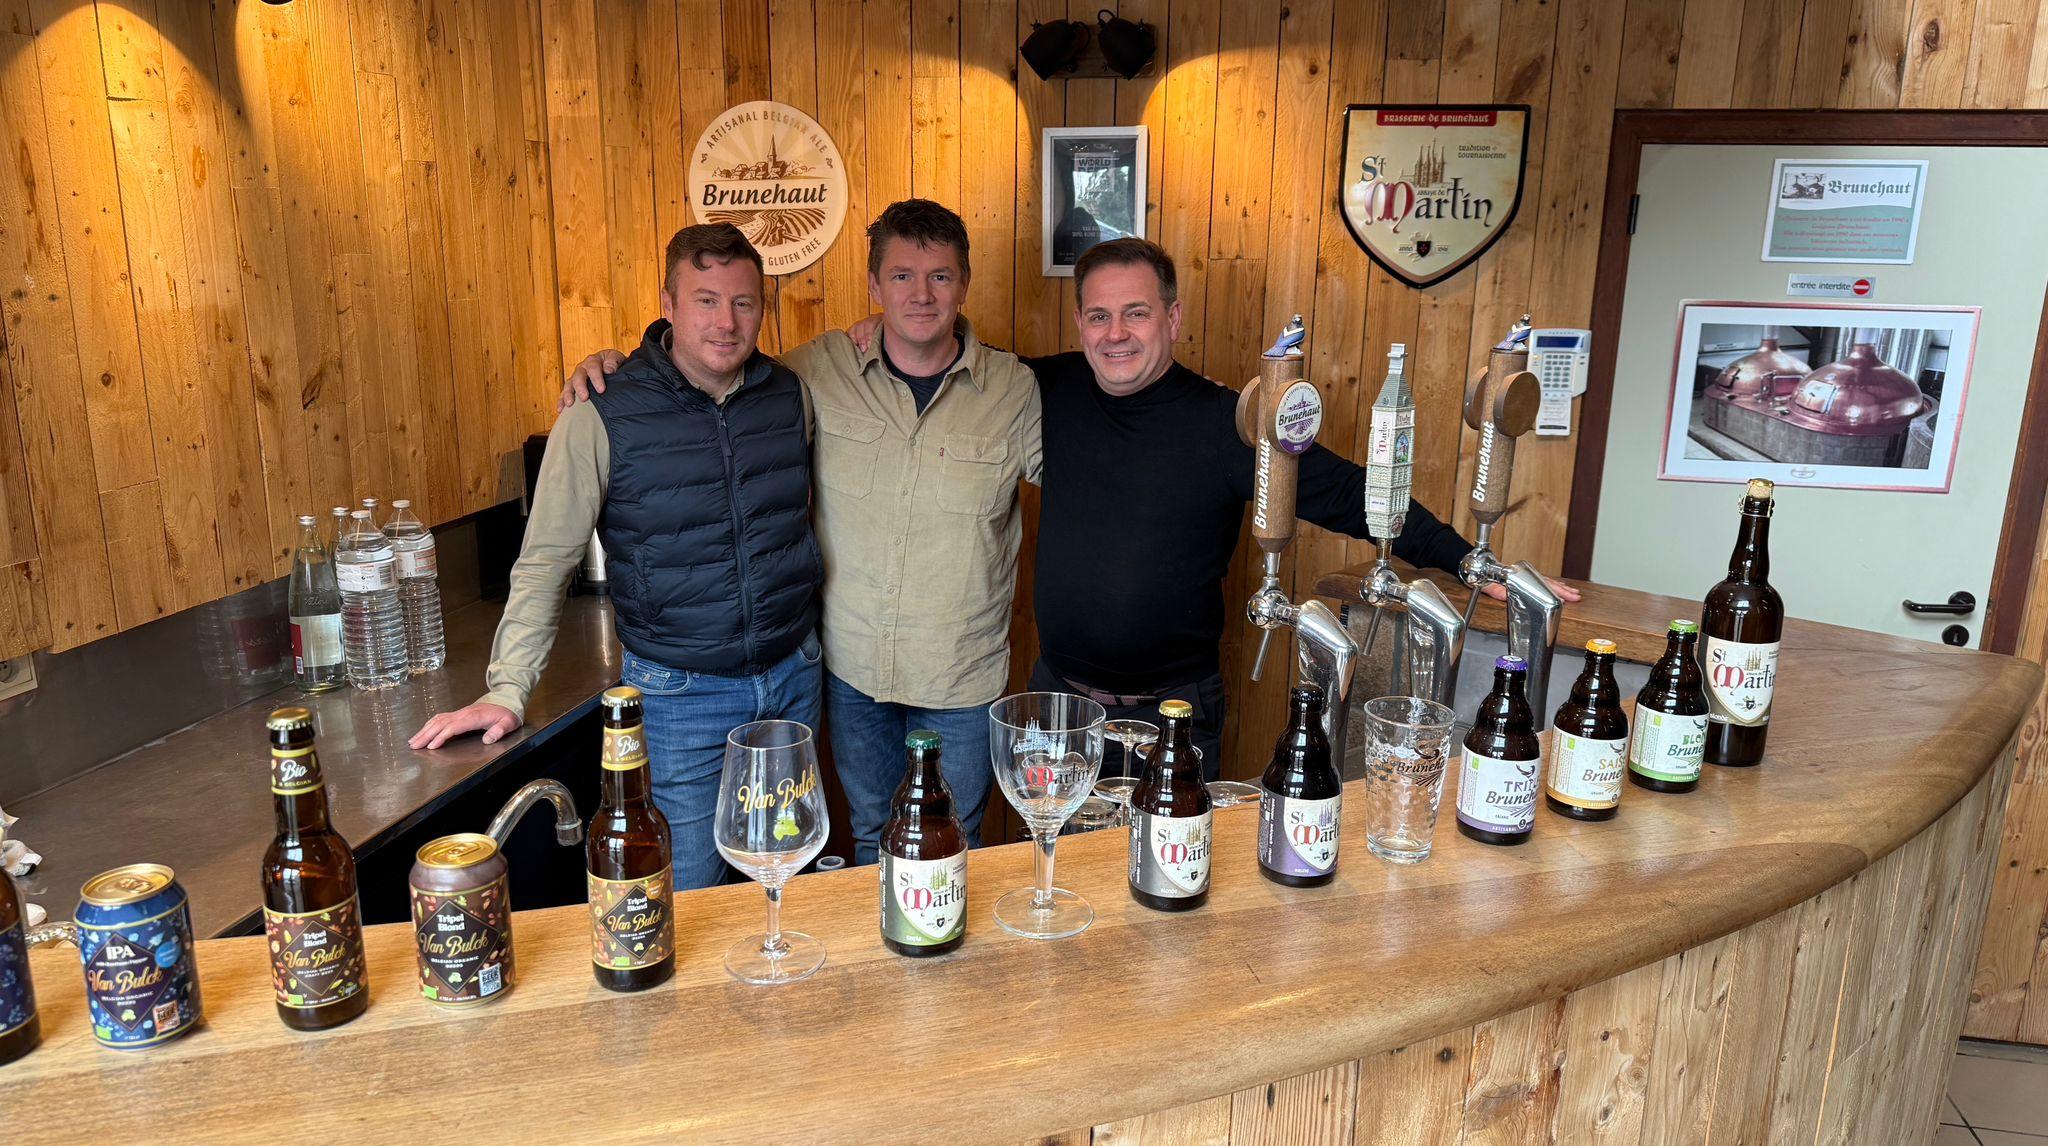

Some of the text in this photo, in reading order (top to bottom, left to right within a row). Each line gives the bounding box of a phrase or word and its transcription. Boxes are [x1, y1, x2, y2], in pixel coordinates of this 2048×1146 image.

[706, 110, 827, 153] ARTISANAL BELGIAN ALE
[1359, 155, 1387, 183] St
[702, 183, 828, 206] Brunehaut
[1828, 179, 1911, 197] Brunehaut
[1364, 177, 1493, 234] Martin
[768, 237, 822, 266] GLUTEN FREE
[1791, 280, 1851, 291] entrée interdite
[1278, 404, 1321, 426] Brunehaut
[1472, 421, 1495, 503] Brunehaut
[1254, 438, 1271, 530] Brunehaut
[1712, 648, 1727, 664] St
[617, 735, 640, 757] Bio
[280, 759, 308, 782] Bio
[738, 764, 817, 814] Van Bulck
[1290, 810, 1304, 824] St
[1157, 828, 1171, 842] St
[900, 871, 913, 886] St
[627, 896, 648, 906] Tripel
[627, 903, 648, 912] Blond
[903, 879, 966, 917] Martin
[437, 914, 465, 924] Tripel
[438, 922, 465, 932] Blond
[606, 913, 631, 932] Van
[303, 930, 327, 940] Tripel
[303, 937, 328, 948] Blond
[420, 929, 489, 958] Van Bulck
[105, 945, 136, 960] IPA
[284, 942, 346, 969] Van Bulck
[454, 955, 480, 964] ORGANIC
[88, 966, 164, 995] Van Bulck
